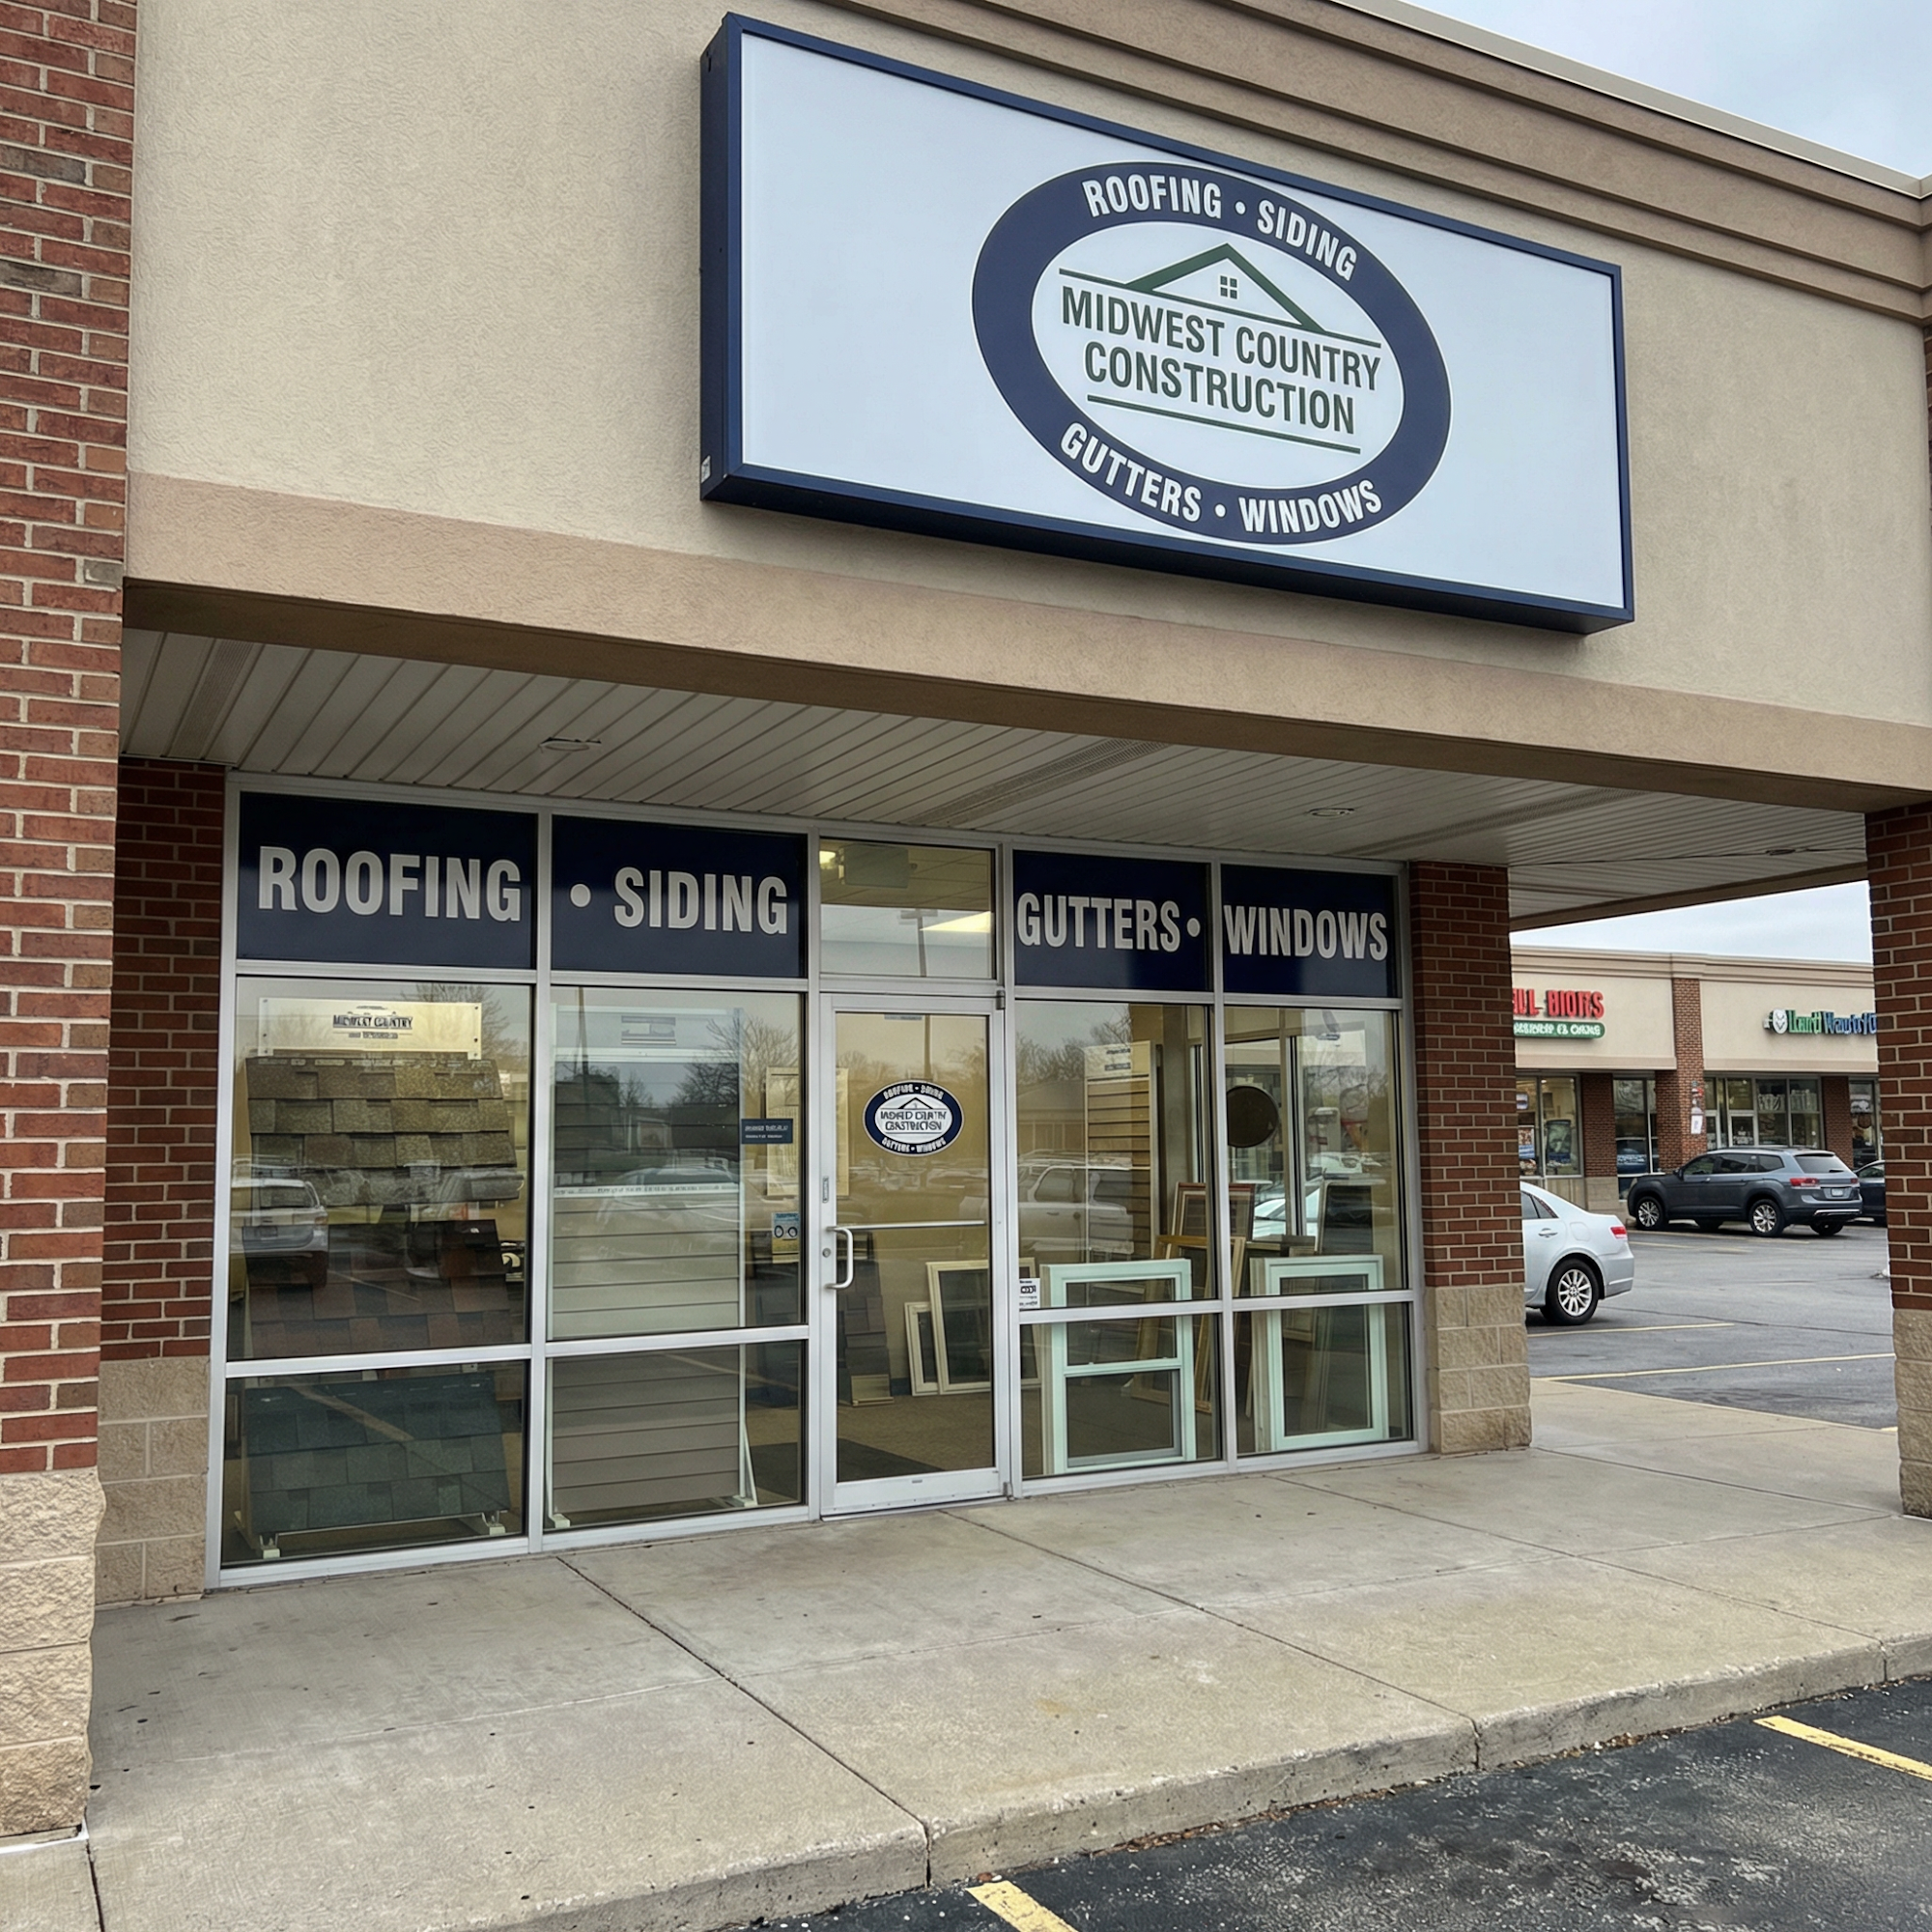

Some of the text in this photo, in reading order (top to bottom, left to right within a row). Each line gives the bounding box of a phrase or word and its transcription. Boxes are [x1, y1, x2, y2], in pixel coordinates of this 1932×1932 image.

[1082, 174, 1358, 280] ROOFING SIDING
[1062, 286, 1381, 391] MIDWEST COUNTRY
[1085, 341, 1354, 435] CONSTRUCTION
[1061, 422, 1382, 534] GUTTERS WINDOWS
[258, 845, 788, 934] ROOFING SIDING
[1017, 893, 1388, 961] GUTTERS WINDOWS
